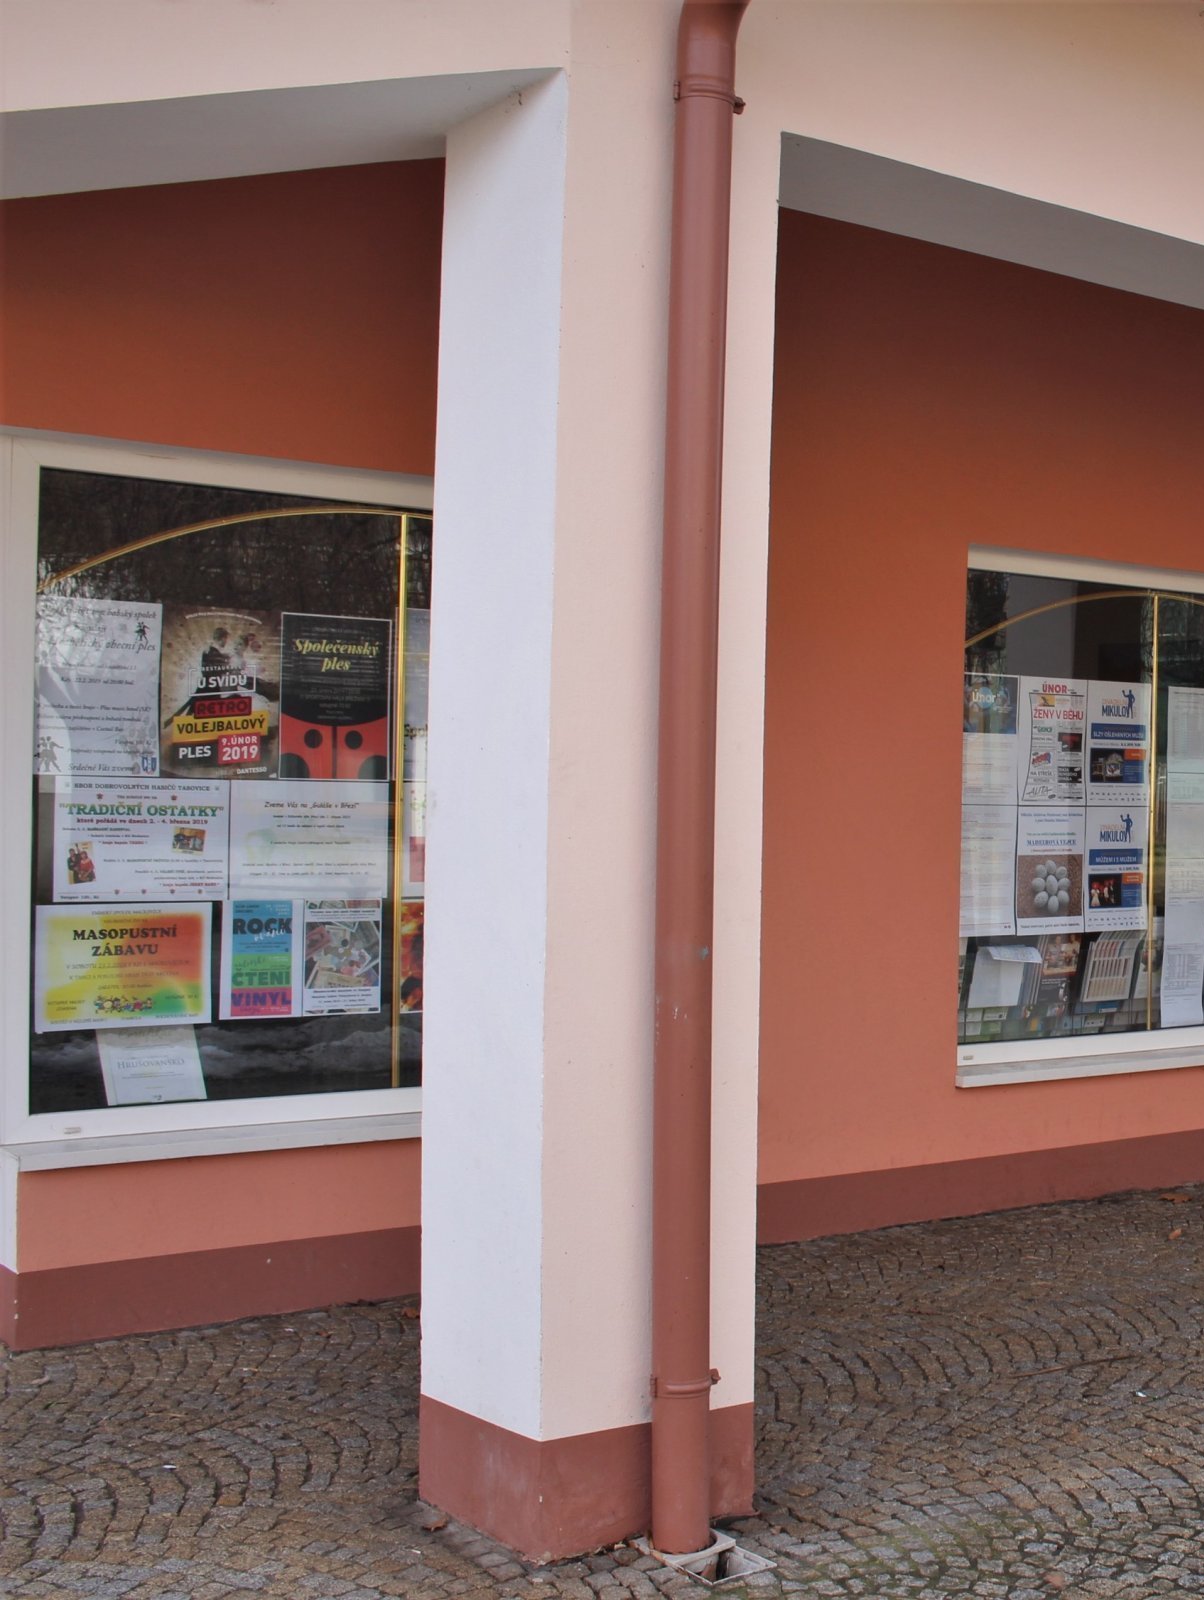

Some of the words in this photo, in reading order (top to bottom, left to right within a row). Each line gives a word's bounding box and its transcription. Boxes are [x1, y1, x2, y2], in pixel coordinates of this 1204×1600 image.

[293, 639, 380, 657] Společenský
[321, 657, 351, 673] ples
[1042, 681, 1068, 694] ÚNOR
[197, 701, 248, 715] RETRO
[177, 715, 265, 735] VOLEJBALOVÝ
[178, 746, 212, 759] PLES
[222, 745, 259, 761] 2019
[72, 924, 178, 941] MASOPUSTNÍ
[233, 917, 293, 935] ROCK
[91, 943, 159, 957] ZÁBAVU
